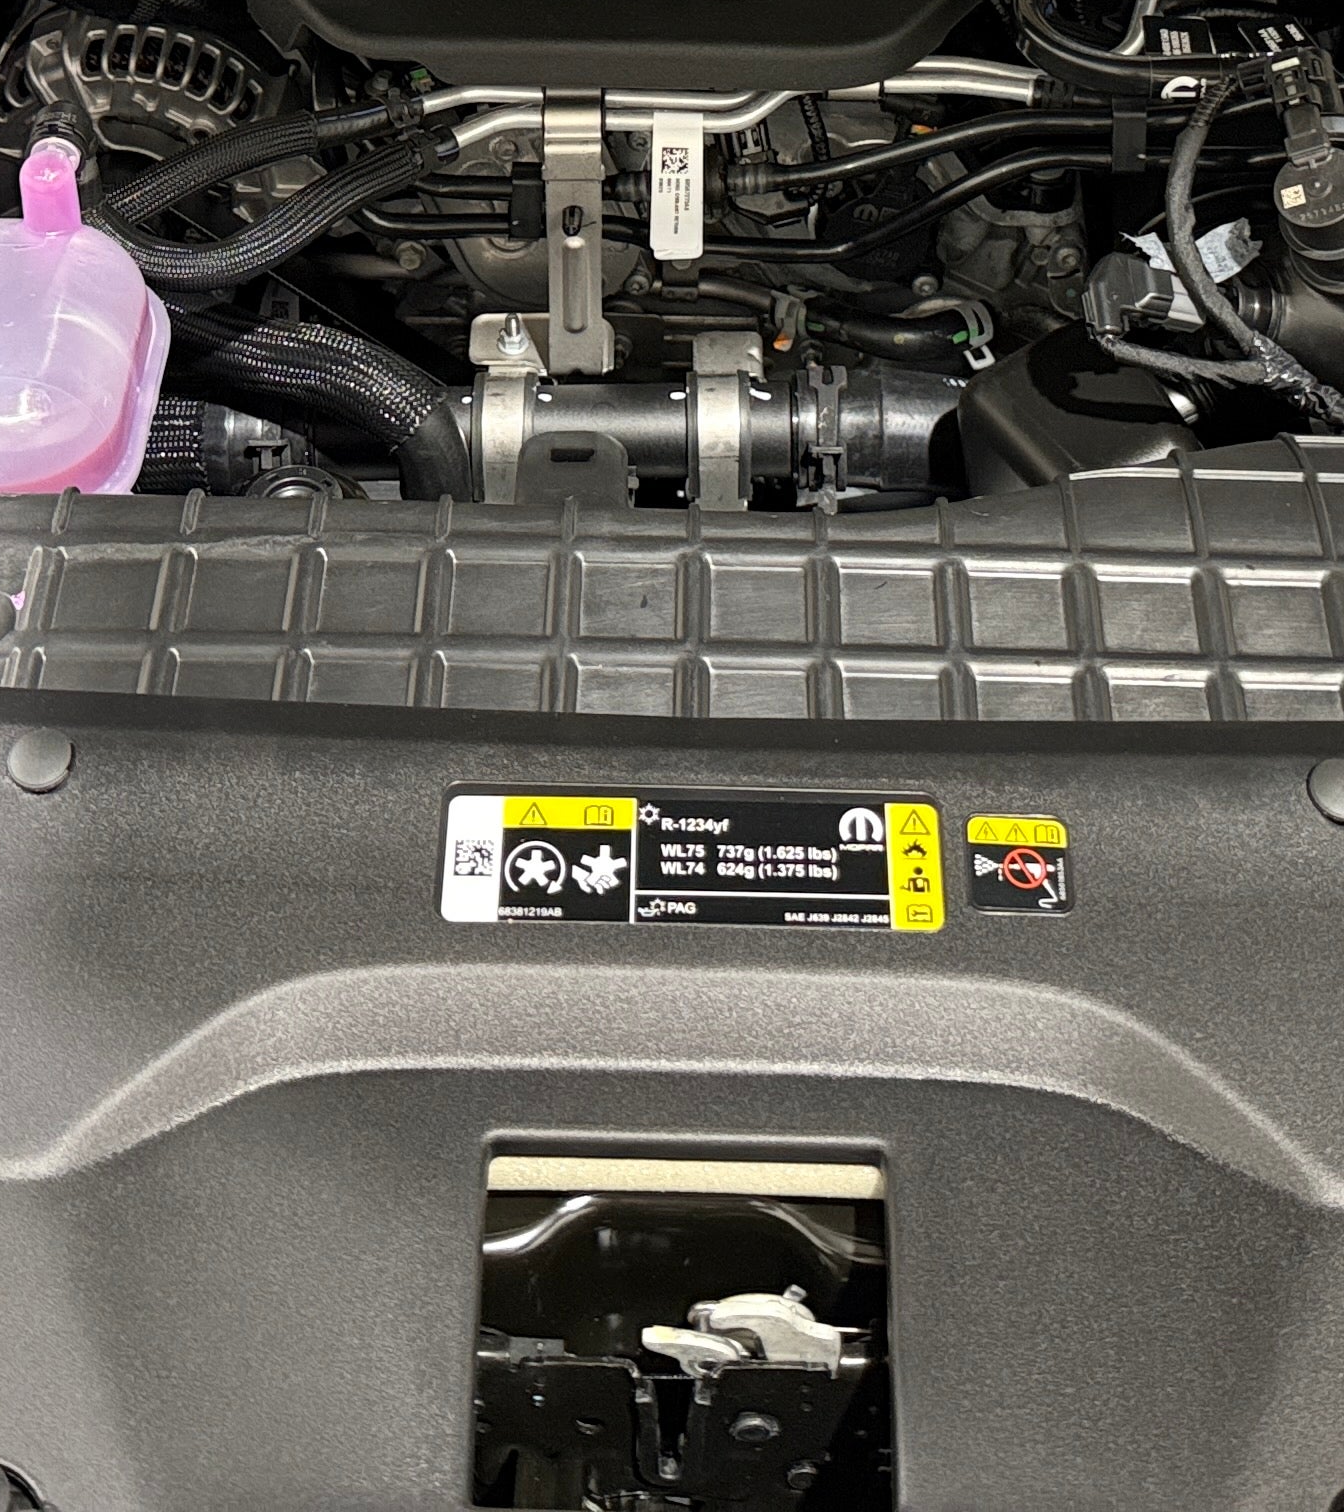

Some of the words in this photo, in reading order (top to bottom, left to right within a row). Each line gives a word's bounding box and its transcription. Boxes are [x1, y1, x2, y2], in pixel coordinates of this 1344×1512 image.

[661, 818, 730, 835] R-1234yf
[660, 843, 705, 858] WL75
[716, 845, 755, 861] 737g
[758, 845, 805, 862] (1.625
[808, 846, 838, 863] lbs)
[839, 843, 884, 852] MOPAR
[660, 861, 705, 875] WL74
[716, 862, 755, 879] 624g
[758, 863, 805, 879] (1.375
[808, 864, 838, 881] lbs)
[667, 901, 697, 915] PAG
[784, 912, 806, 922] SAE
